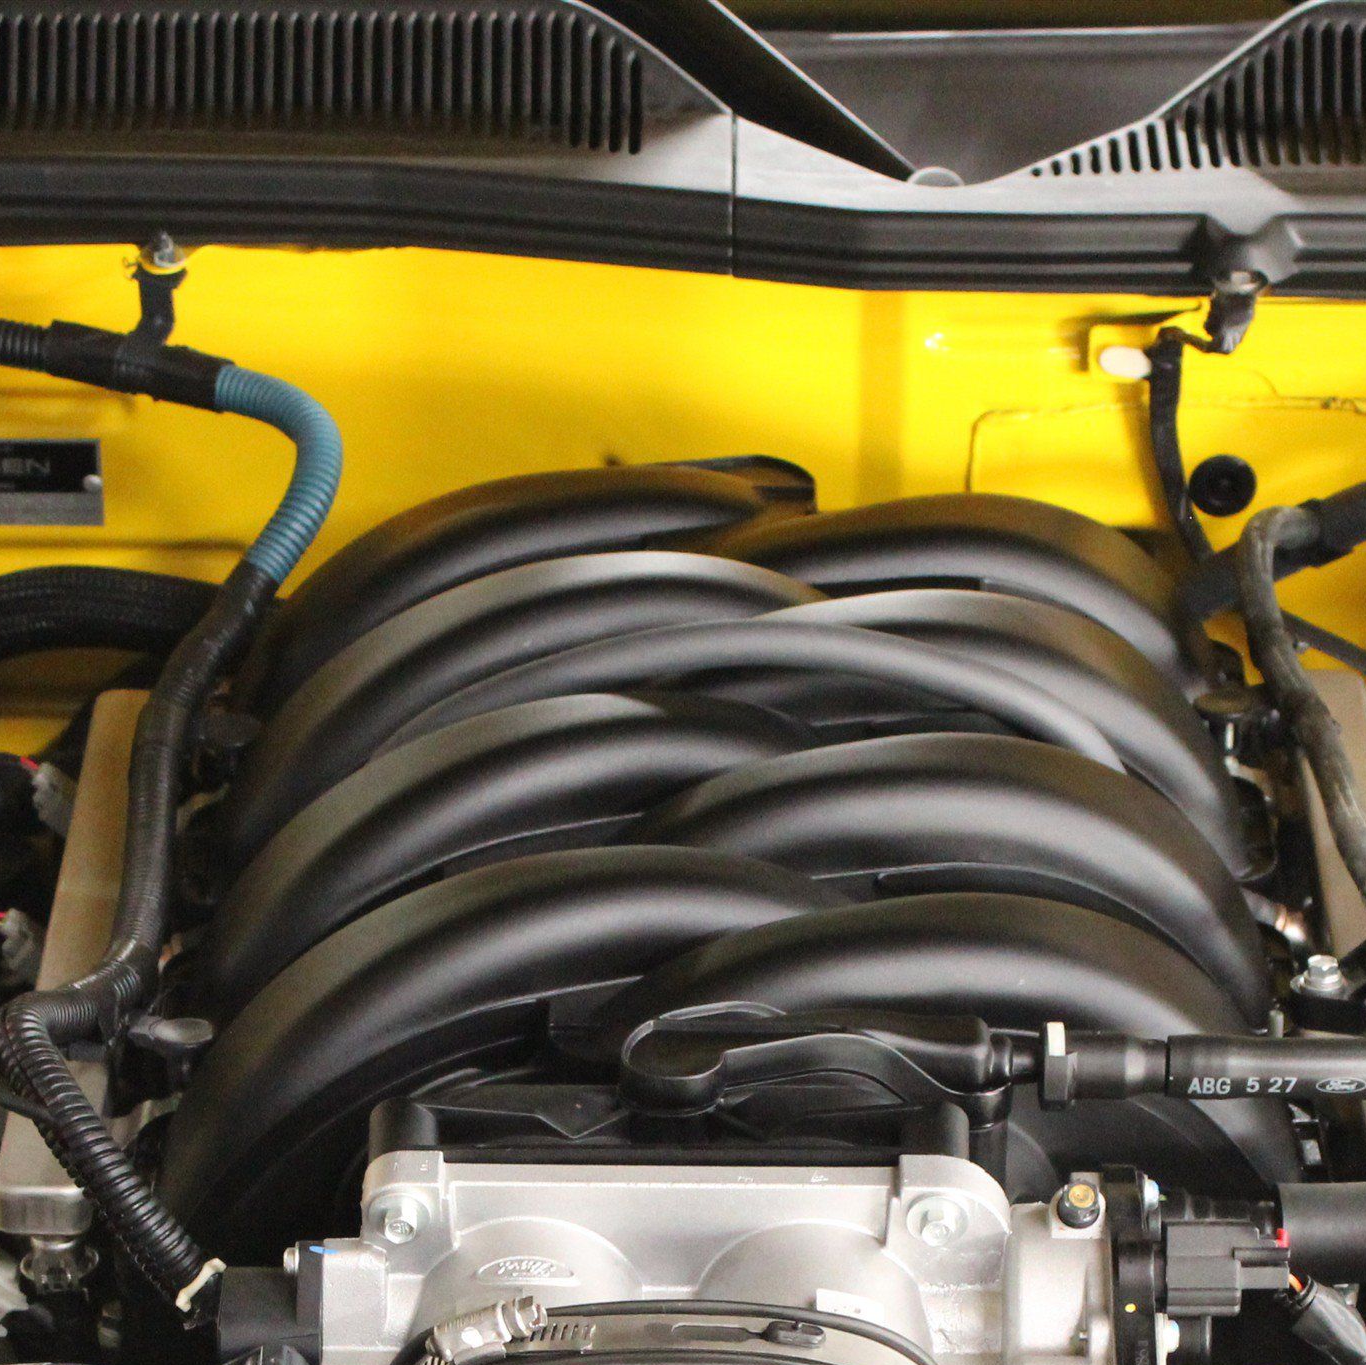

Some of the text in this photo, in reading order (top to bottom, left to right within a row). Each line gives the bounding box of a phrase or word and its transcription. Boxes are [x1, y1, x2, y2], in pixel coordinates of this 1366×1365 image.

[1187, 1077, 1231, 1094] ABG
[1246, 1077, 1260, 1093] 5
[1267, 1077, 1299, 1093] 27
